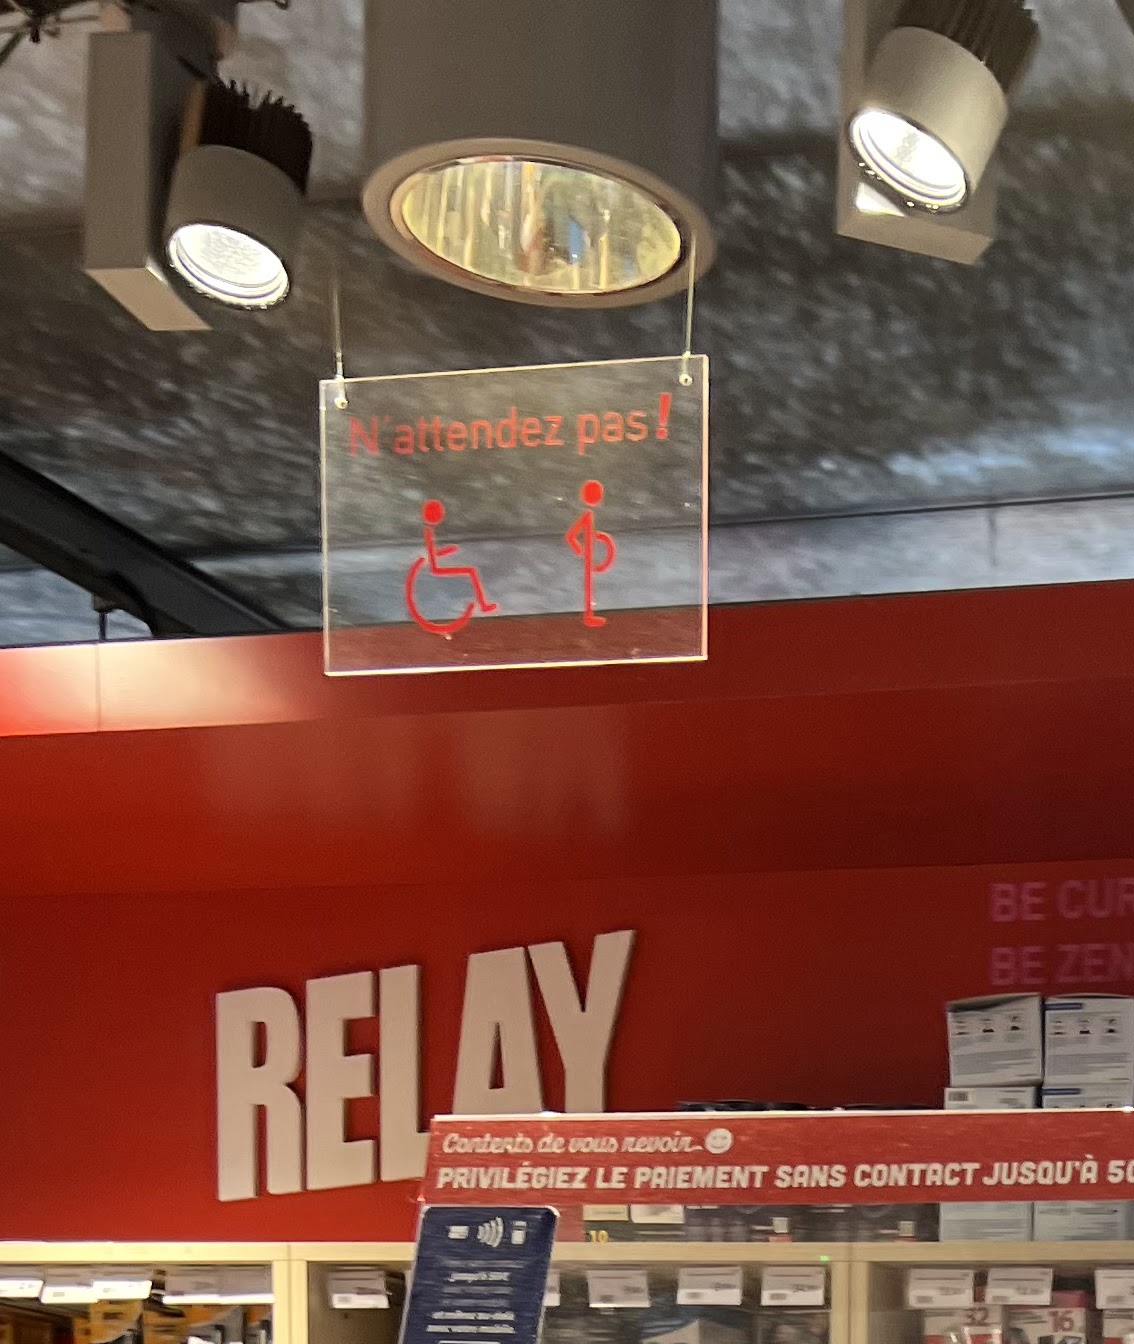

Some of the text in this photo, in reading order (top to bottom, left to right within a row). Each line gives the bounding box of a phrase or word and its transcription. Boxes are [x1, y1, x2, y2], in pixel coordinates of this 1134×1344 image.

[348, 407, 563, 456] N'attendez
[990, 881, 1046, 923] BE
[991, 945, 1046, 986] BE
[215, 930, 636, 1202] RELAY
[442, 1131, 533, 1154] Contents
[537, 1132, 565, 1154] de
[568, 1136, 619, 1154] vous
[436, 1162, 592, 1190] PRIVILÉGIEZ
[595, 1167, 630, 1189] LE
[634, 1165, 770, 1189] PAIEMENT
[774, 1164, 846, 1188] SANS
[853, 1162, 981, 1188] CONTACT
[982, 1154, 1099, 1186] JUSQU'À
